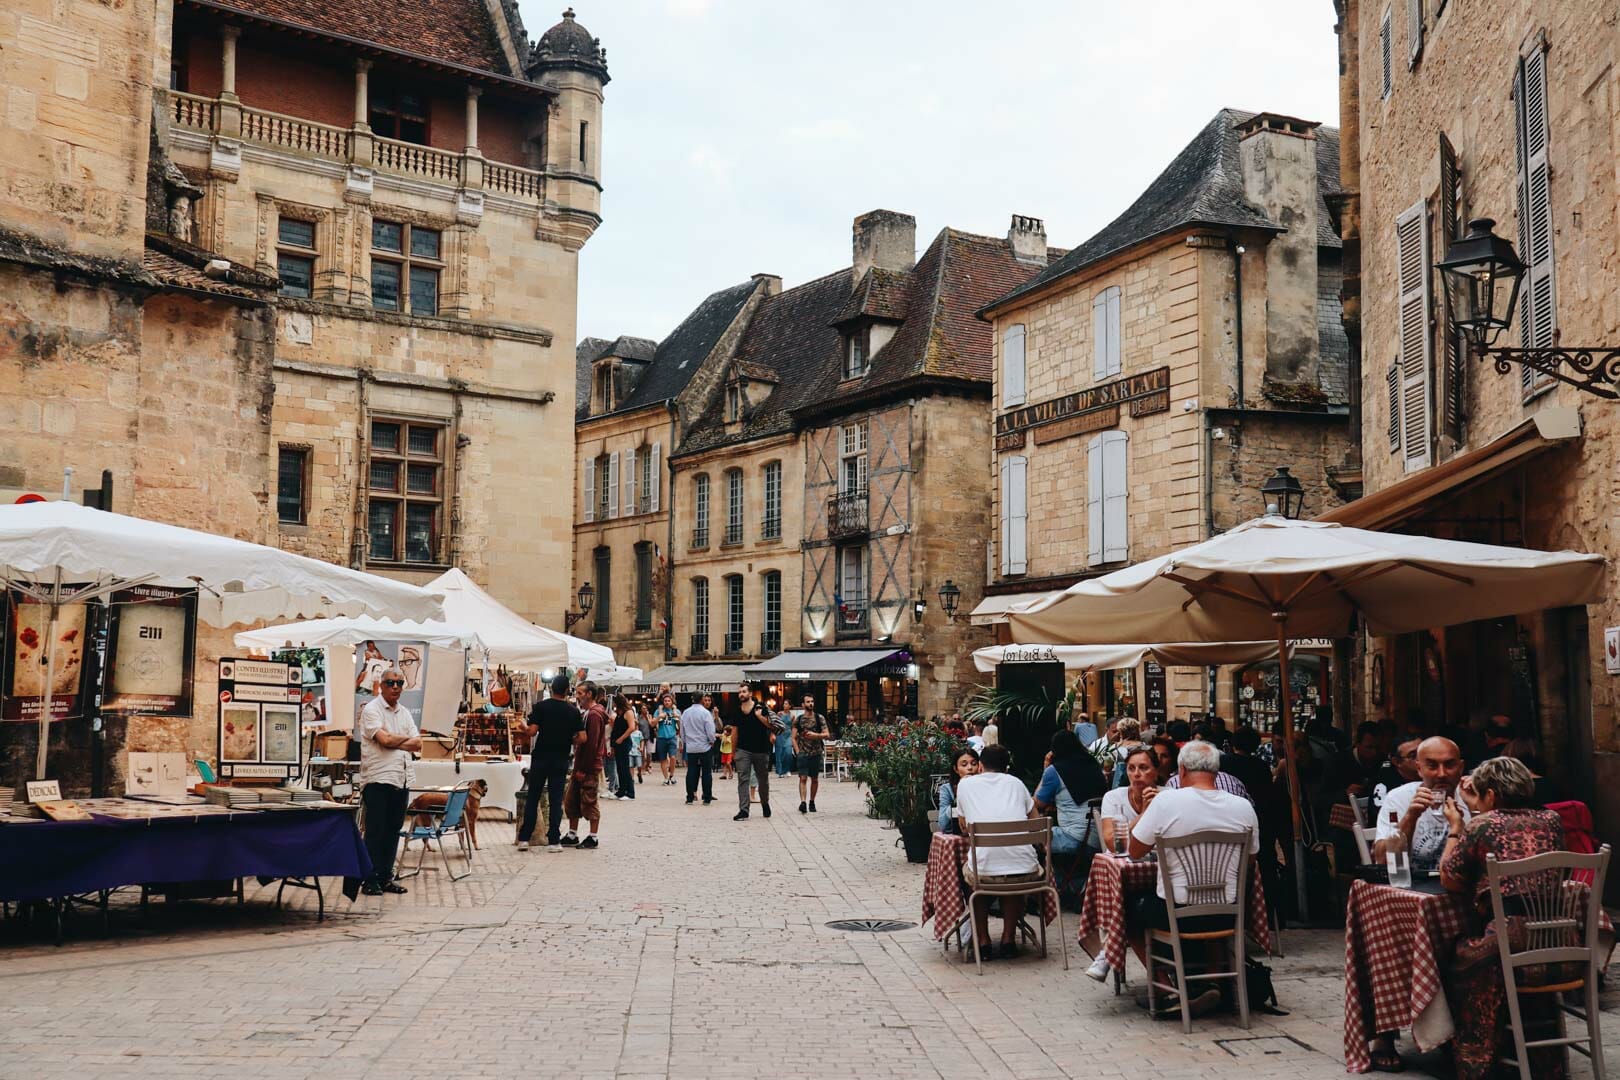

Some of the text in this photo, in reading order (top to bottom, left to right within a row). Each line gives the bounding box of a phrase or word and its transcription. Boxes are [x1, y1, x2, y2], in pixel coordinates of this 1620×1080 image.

[1001, 415, 1010, 431] A
[1014, 410, 1030, 428] LA
[1035, 397, 1073, 422] VILLE
[1101, 372, 1161, 404] SARLAT
[134, 587, 150, 596] Livre
[139, 626, 162, 639] 2111
